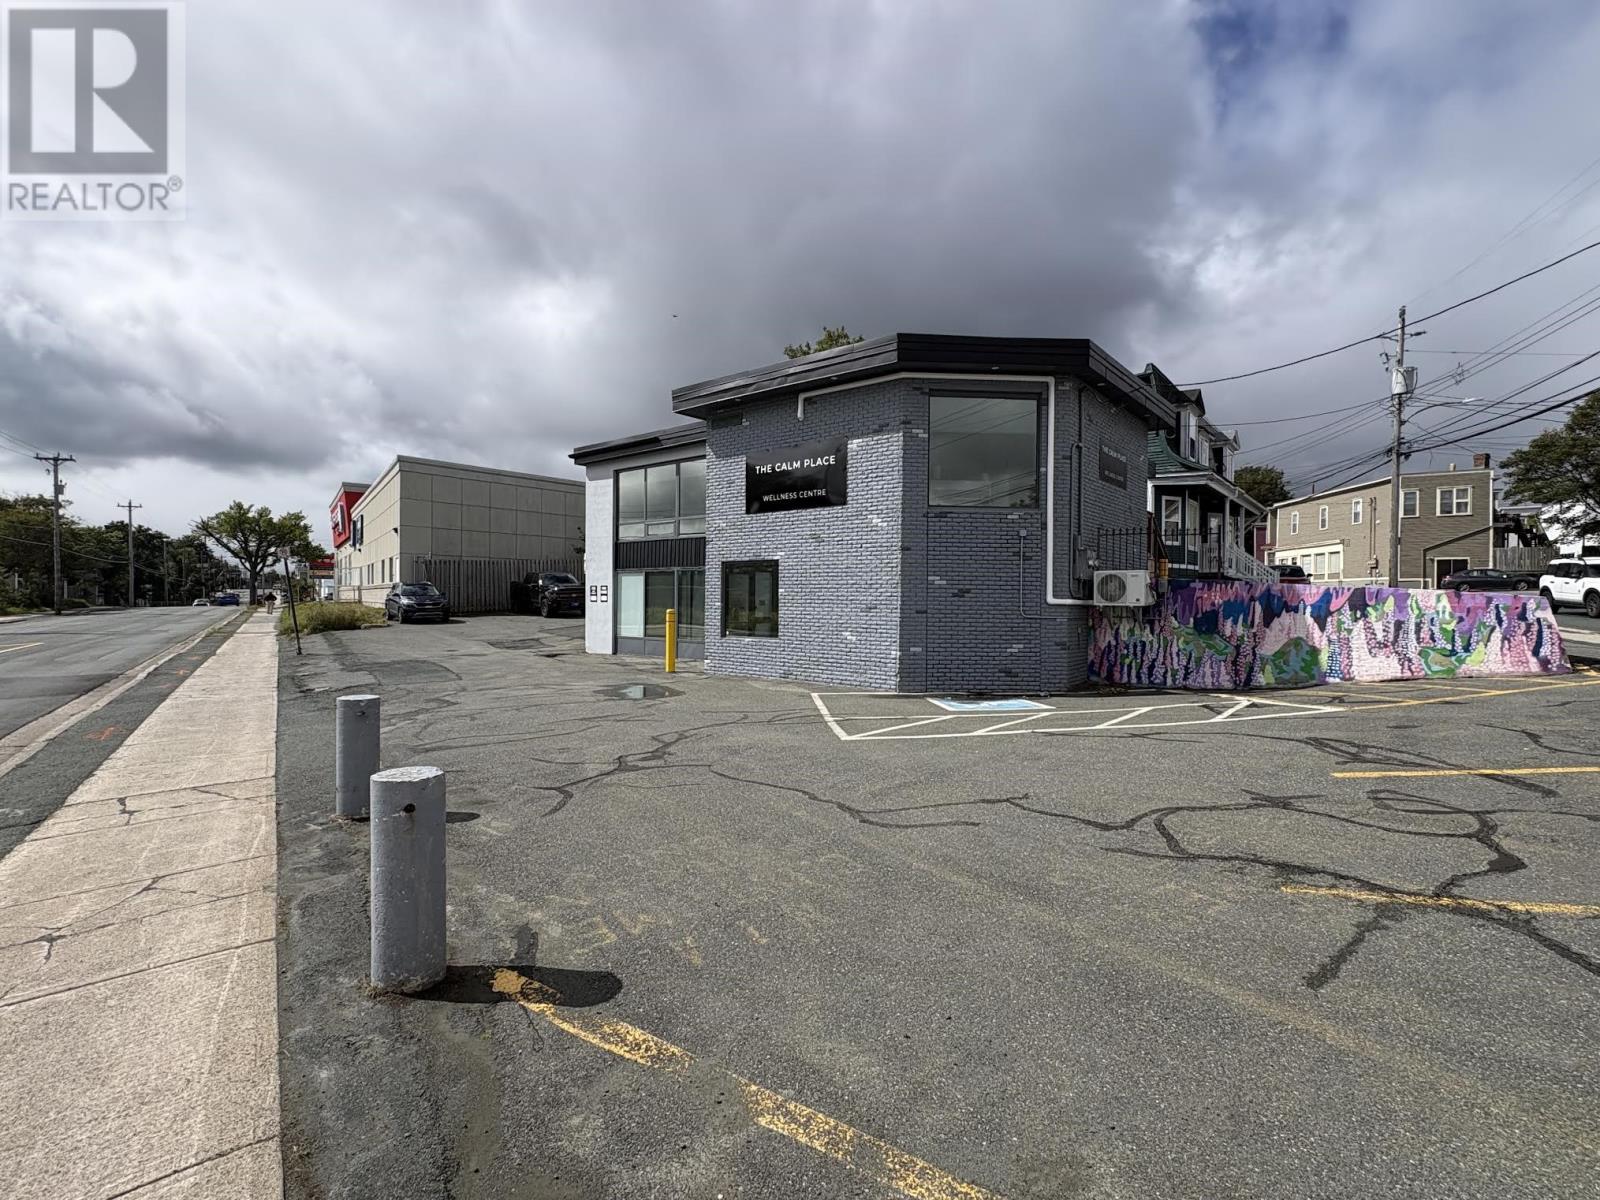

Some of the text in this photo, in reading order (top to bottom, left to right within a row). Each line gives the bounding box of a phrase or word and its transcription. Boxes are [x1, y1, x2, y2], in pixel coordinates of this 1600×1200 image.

[755, 455, 836, 475] THE CALM PLACE
[762, 488, 827, 502] WELLNESS CENTRE
